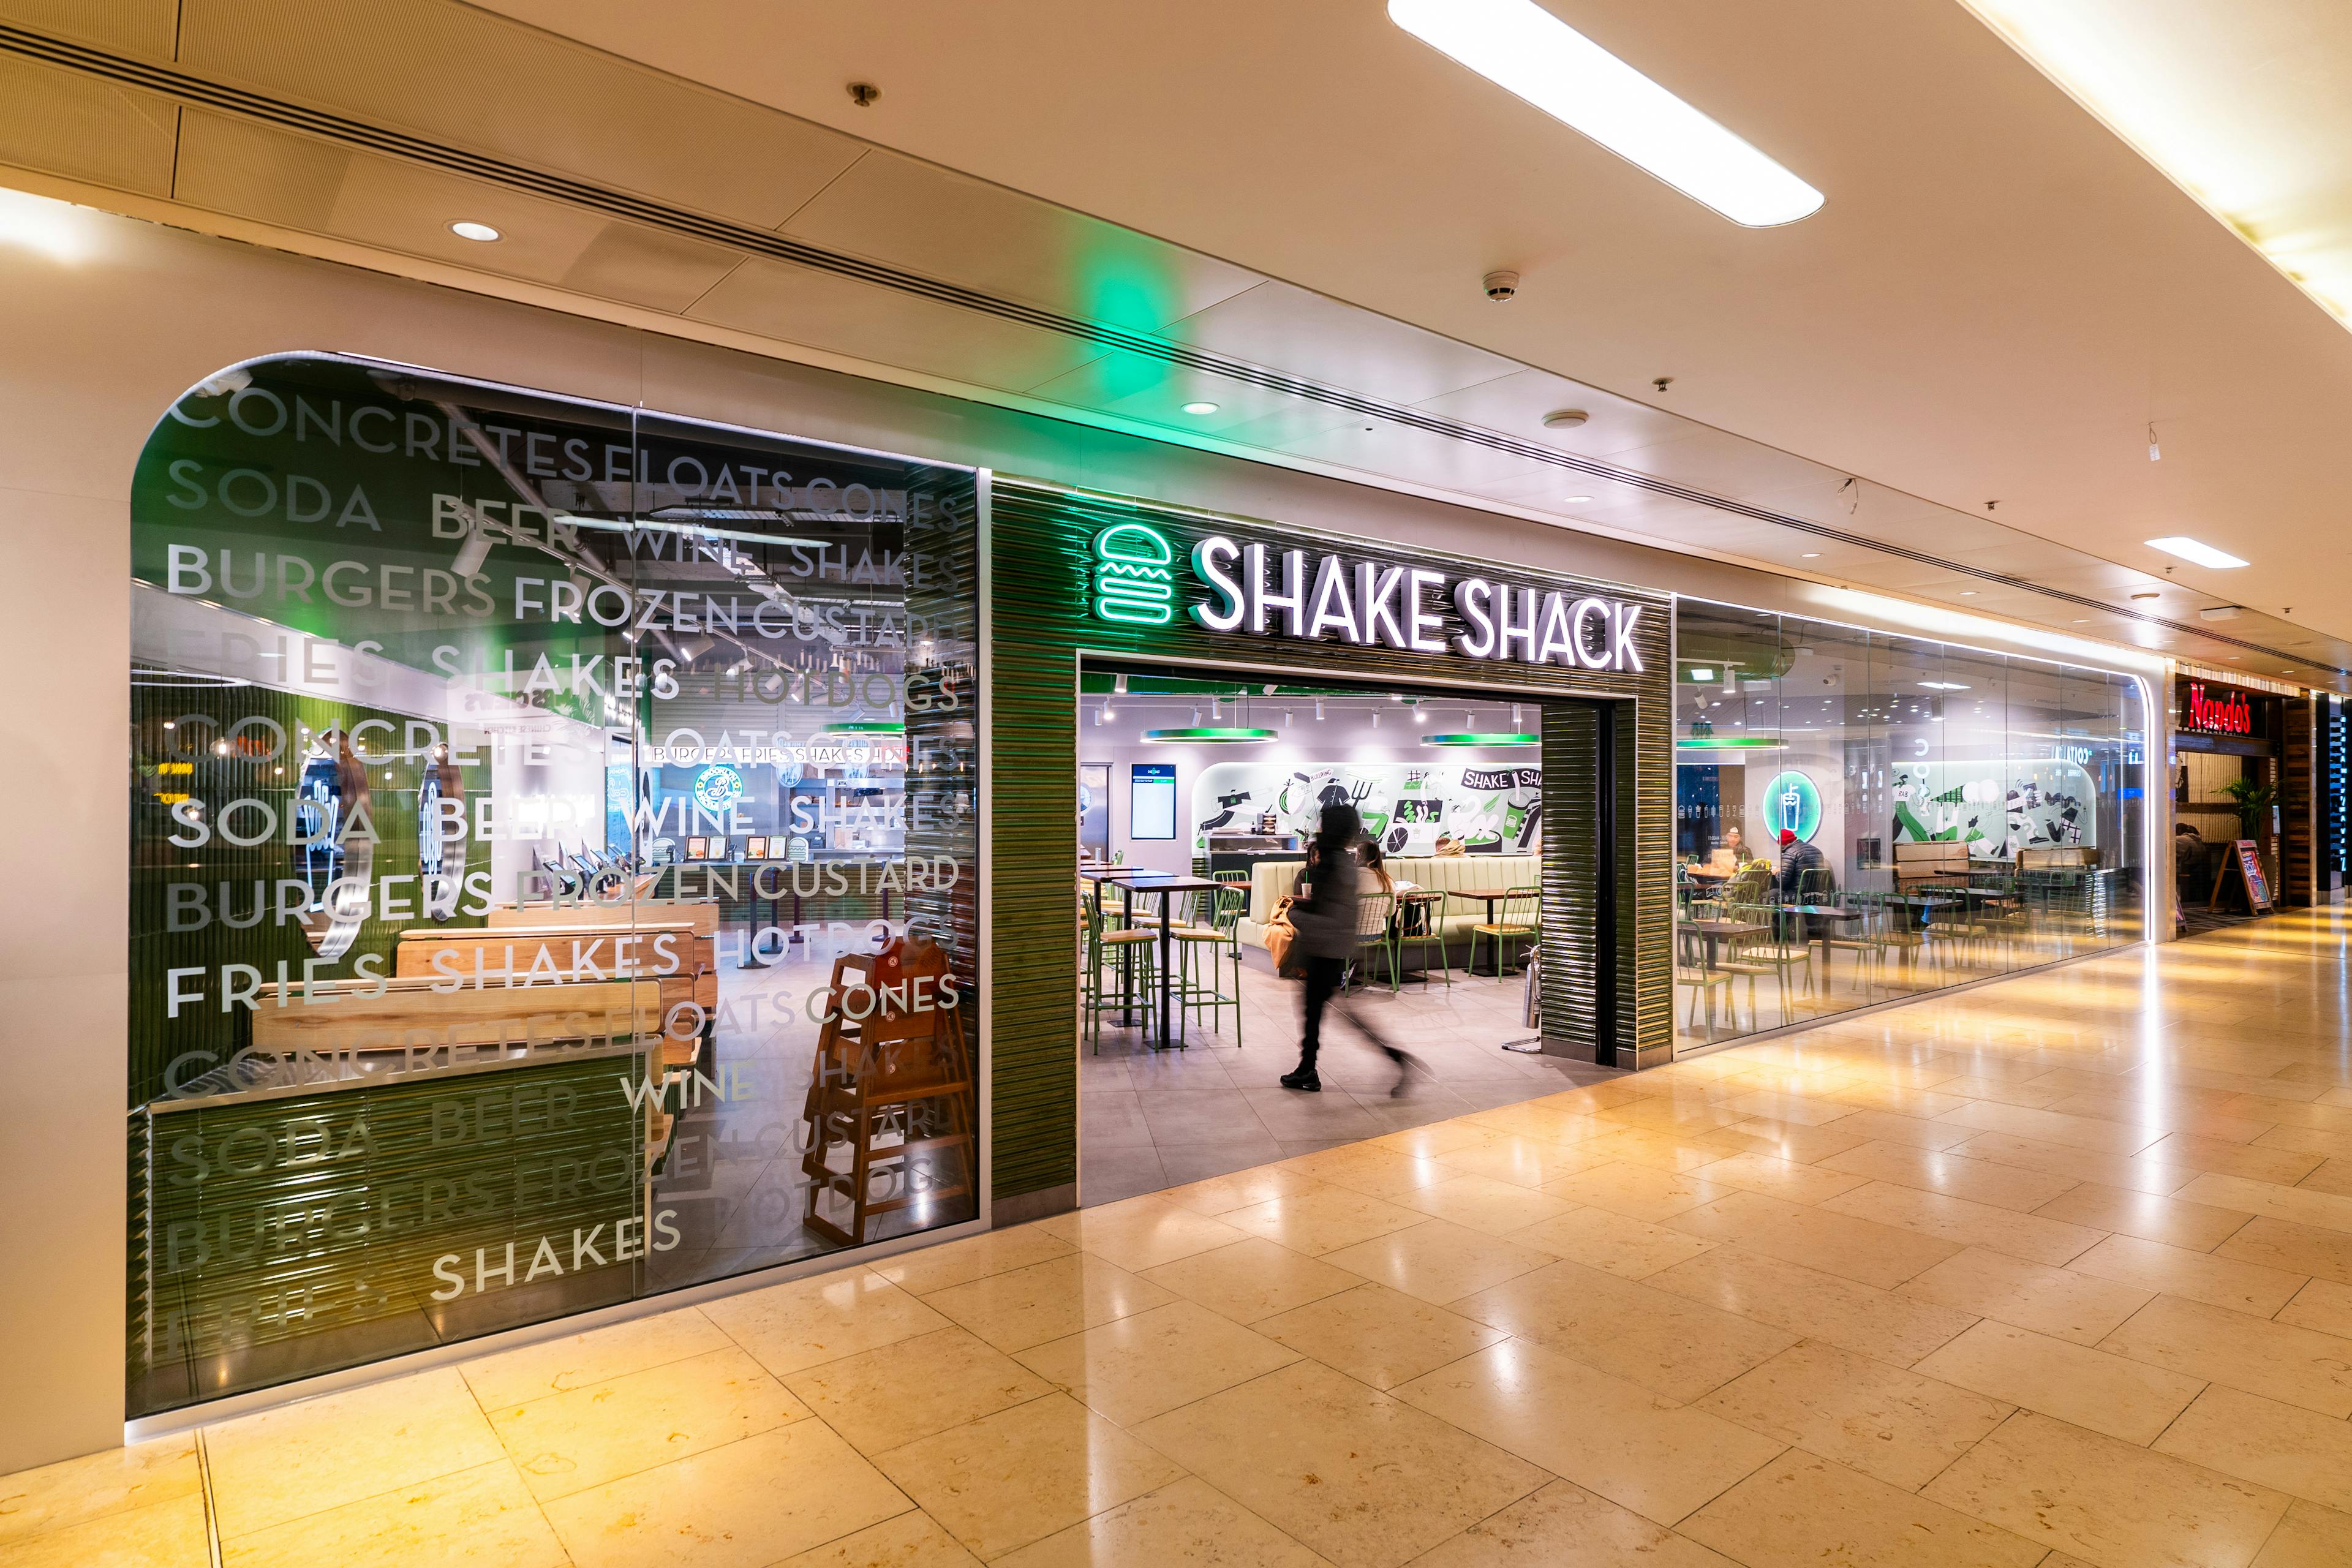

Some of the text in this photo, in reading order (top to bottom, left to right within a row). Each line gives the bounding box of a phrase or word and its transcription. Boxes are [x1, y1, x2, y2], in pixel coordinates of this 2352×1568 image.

[168, 381, 959, 532] CONCRETES FLOATS CONES
[166, 459, 959, 592] SODA BEER WINE SHAKES
[168, 544, 959, 648] BURGERS FROZEN CUSTARD
[1191, 536, 1644, 673] SHAKE SHACK
[431, 644, 679, 699] SHAKES
[2188, 682, 2251, 734] Nando's
[165, 714, 586, 766] CONCRETES
[605, 727, 795, 769] FLOATS
[1464, 772, 1508, 789] SHAKE
[167, 798, 382, 848] SODA
[431, 797, 579, 842] BEER
[617, 796, 756, 837] WINE
[789, 795, 959, 835] SHAKES
[167, 855, 959, 933] BURGERS FROZEN CUSTARD
[167, 953, 388, 1019] FRIES
[430, 933, 680, 993] SHAKES
[164, 973, 959, 1101] CONCRETES FLOATS CONES
[168, 1114, 380, 1186] SODA
[431, 1086, 579, 1147] BEER
[619, 1061, 758, 1115] WINE
[167, 1171, 495, 1275] BURGERS
[516, 1128, 739, 1208] FROZEN
[430, 1209, 681, 1301] SHAKES
